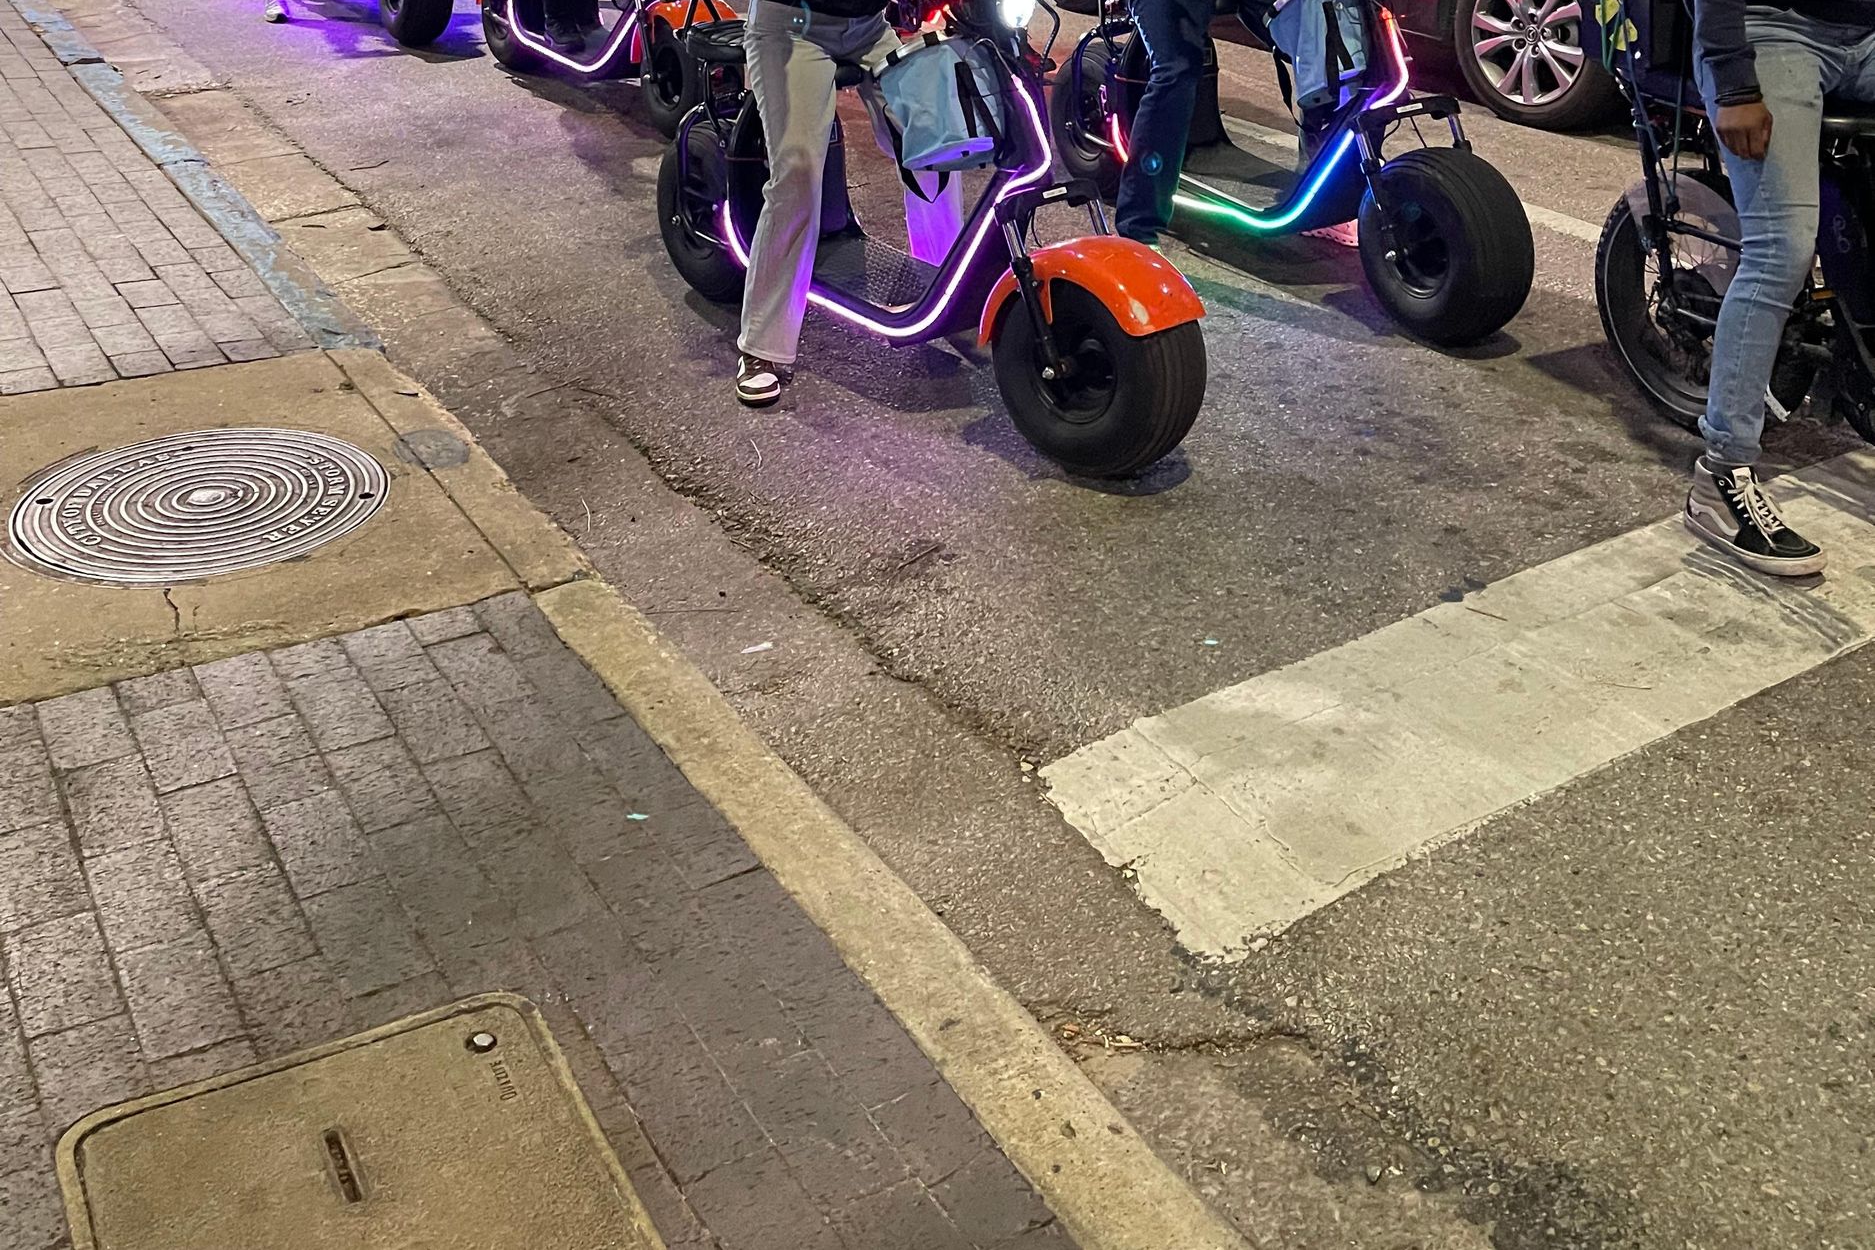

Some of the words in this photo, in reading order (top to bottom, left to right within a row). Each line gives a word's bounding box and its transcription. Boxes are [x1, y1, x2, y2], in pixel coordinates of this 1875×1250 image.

[72, 452, 171, 498] DALLAS
[308, 456, 346, 496] STORM
[61, 500, 84, 519] OF
[262, 498, 339, 542] SEWER
[61, 517, 102, 546] CITY
